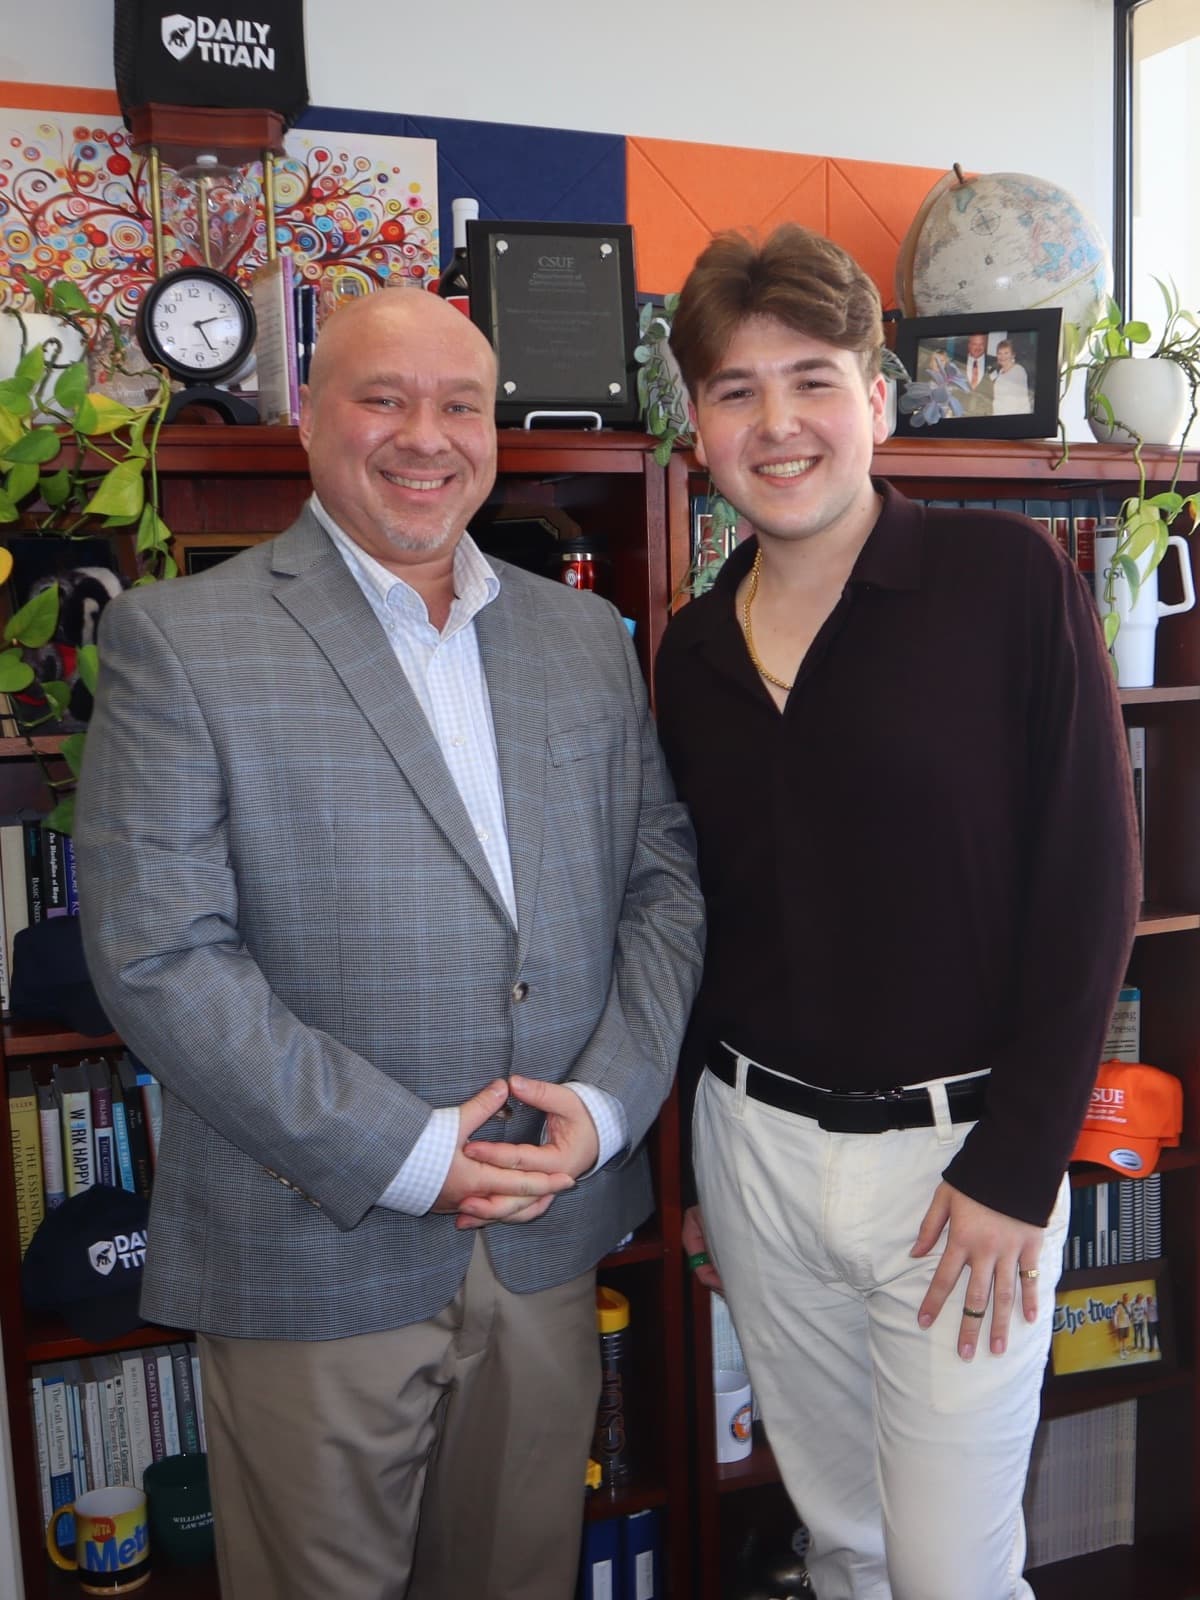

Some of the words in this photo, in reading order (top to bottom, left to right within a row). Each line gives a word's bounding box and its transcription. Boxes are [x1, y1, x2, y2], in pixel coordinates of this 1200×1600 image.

[197, 16, 272, 44] DAILY
[197, 40, 275, 71] TITAN
[538, 256, 576, 268] CSUF
[187, 288, 200, 298] 12
[164, 304, 176, 313] 10
[219, 303, 226, 313] 2
[160, 321, 169, 330] 9
[195, 352, 204, 362] 6
[25, 1144, 36, 1169] THE
[11, 1129, 25, 1210] DEPARTMENT
[73, 1148, 89, 1186] HAPPY
[147, 1363, 158, 1408] CREATIVE
[52, 1388, 61, 1403] The
[54, 1405, 64, 1424] Craft
